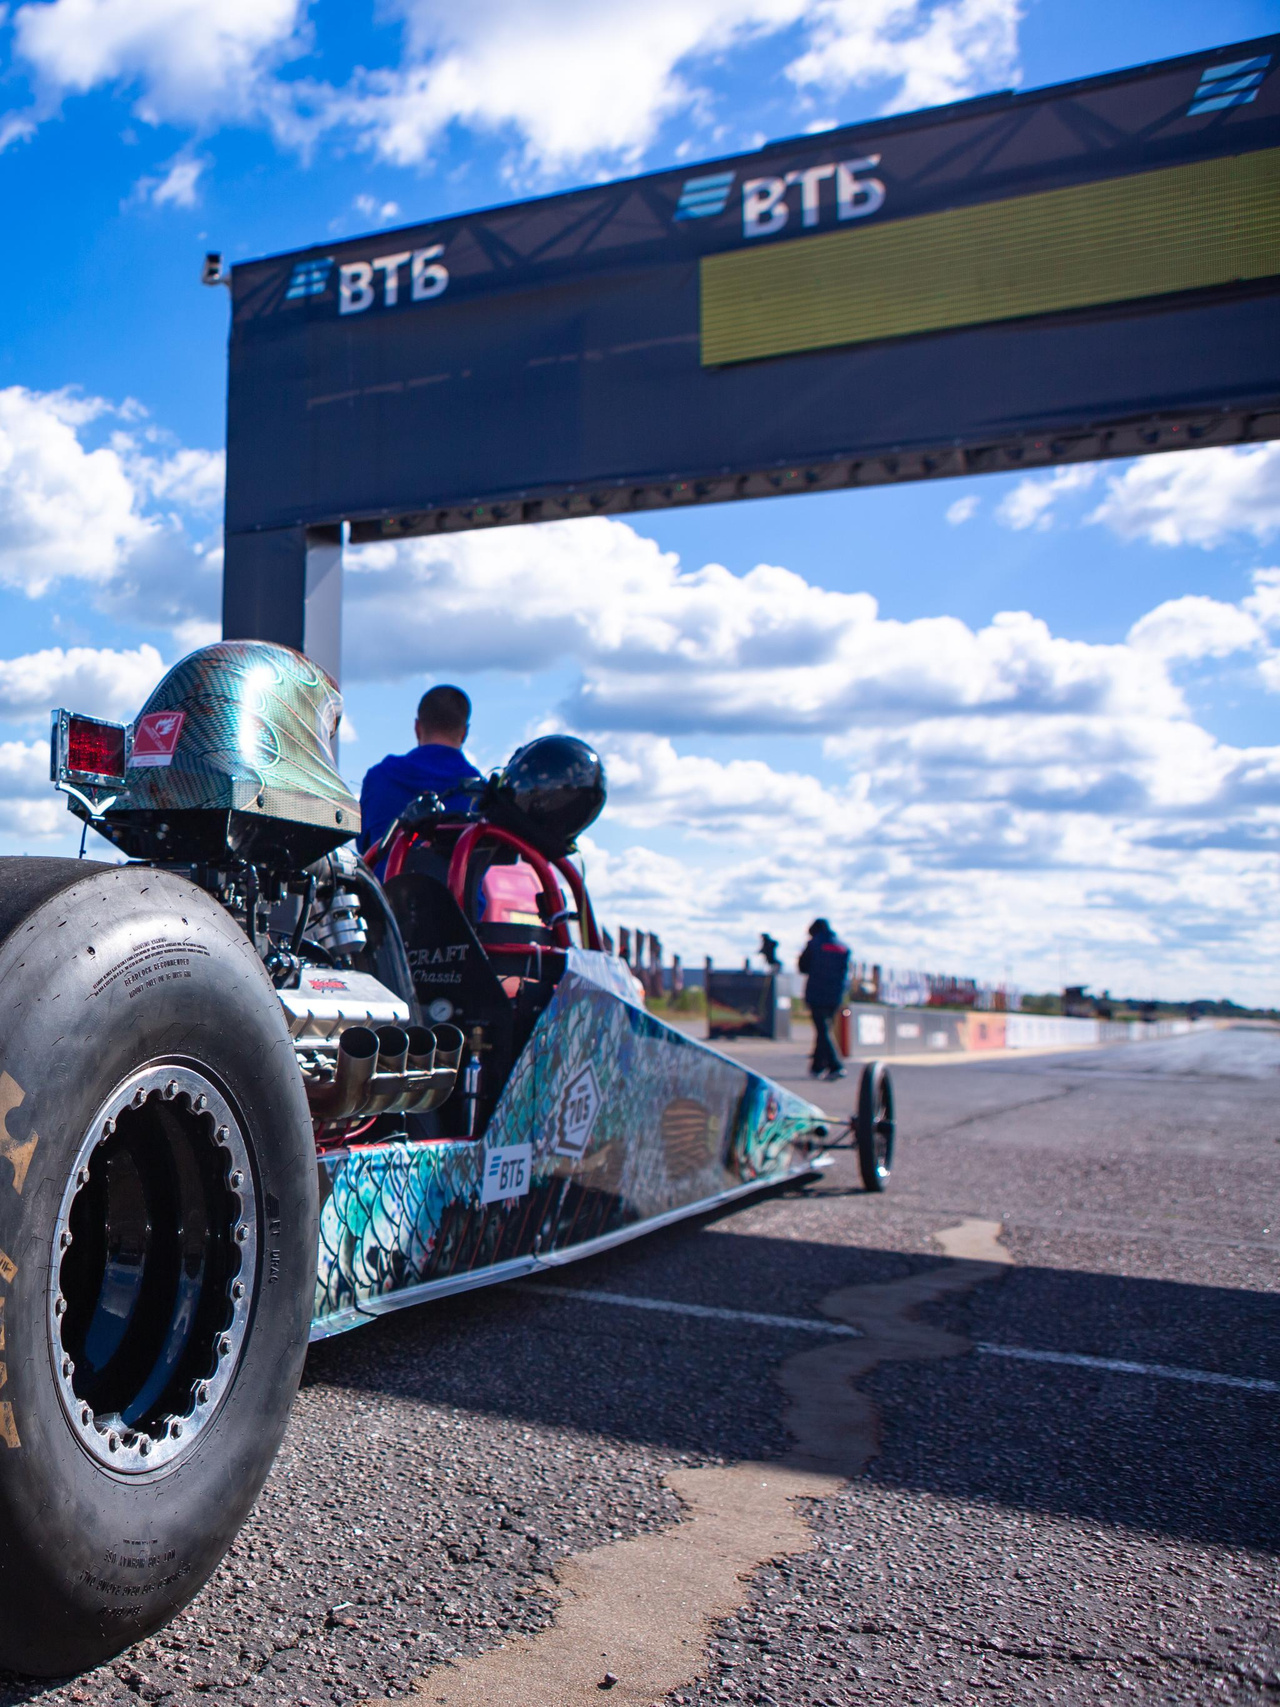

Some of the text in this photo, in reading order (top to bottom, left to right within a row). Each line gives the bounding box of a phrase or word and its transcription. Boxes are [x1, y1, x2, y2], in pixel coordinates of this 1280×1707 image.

[742, 153, 887, 238] ВТБ
[338, 244, 449, 316] ВТБ
[413, 969, 462, 983] Chassis
[499, 1158, 525, 1191] ВТБ
